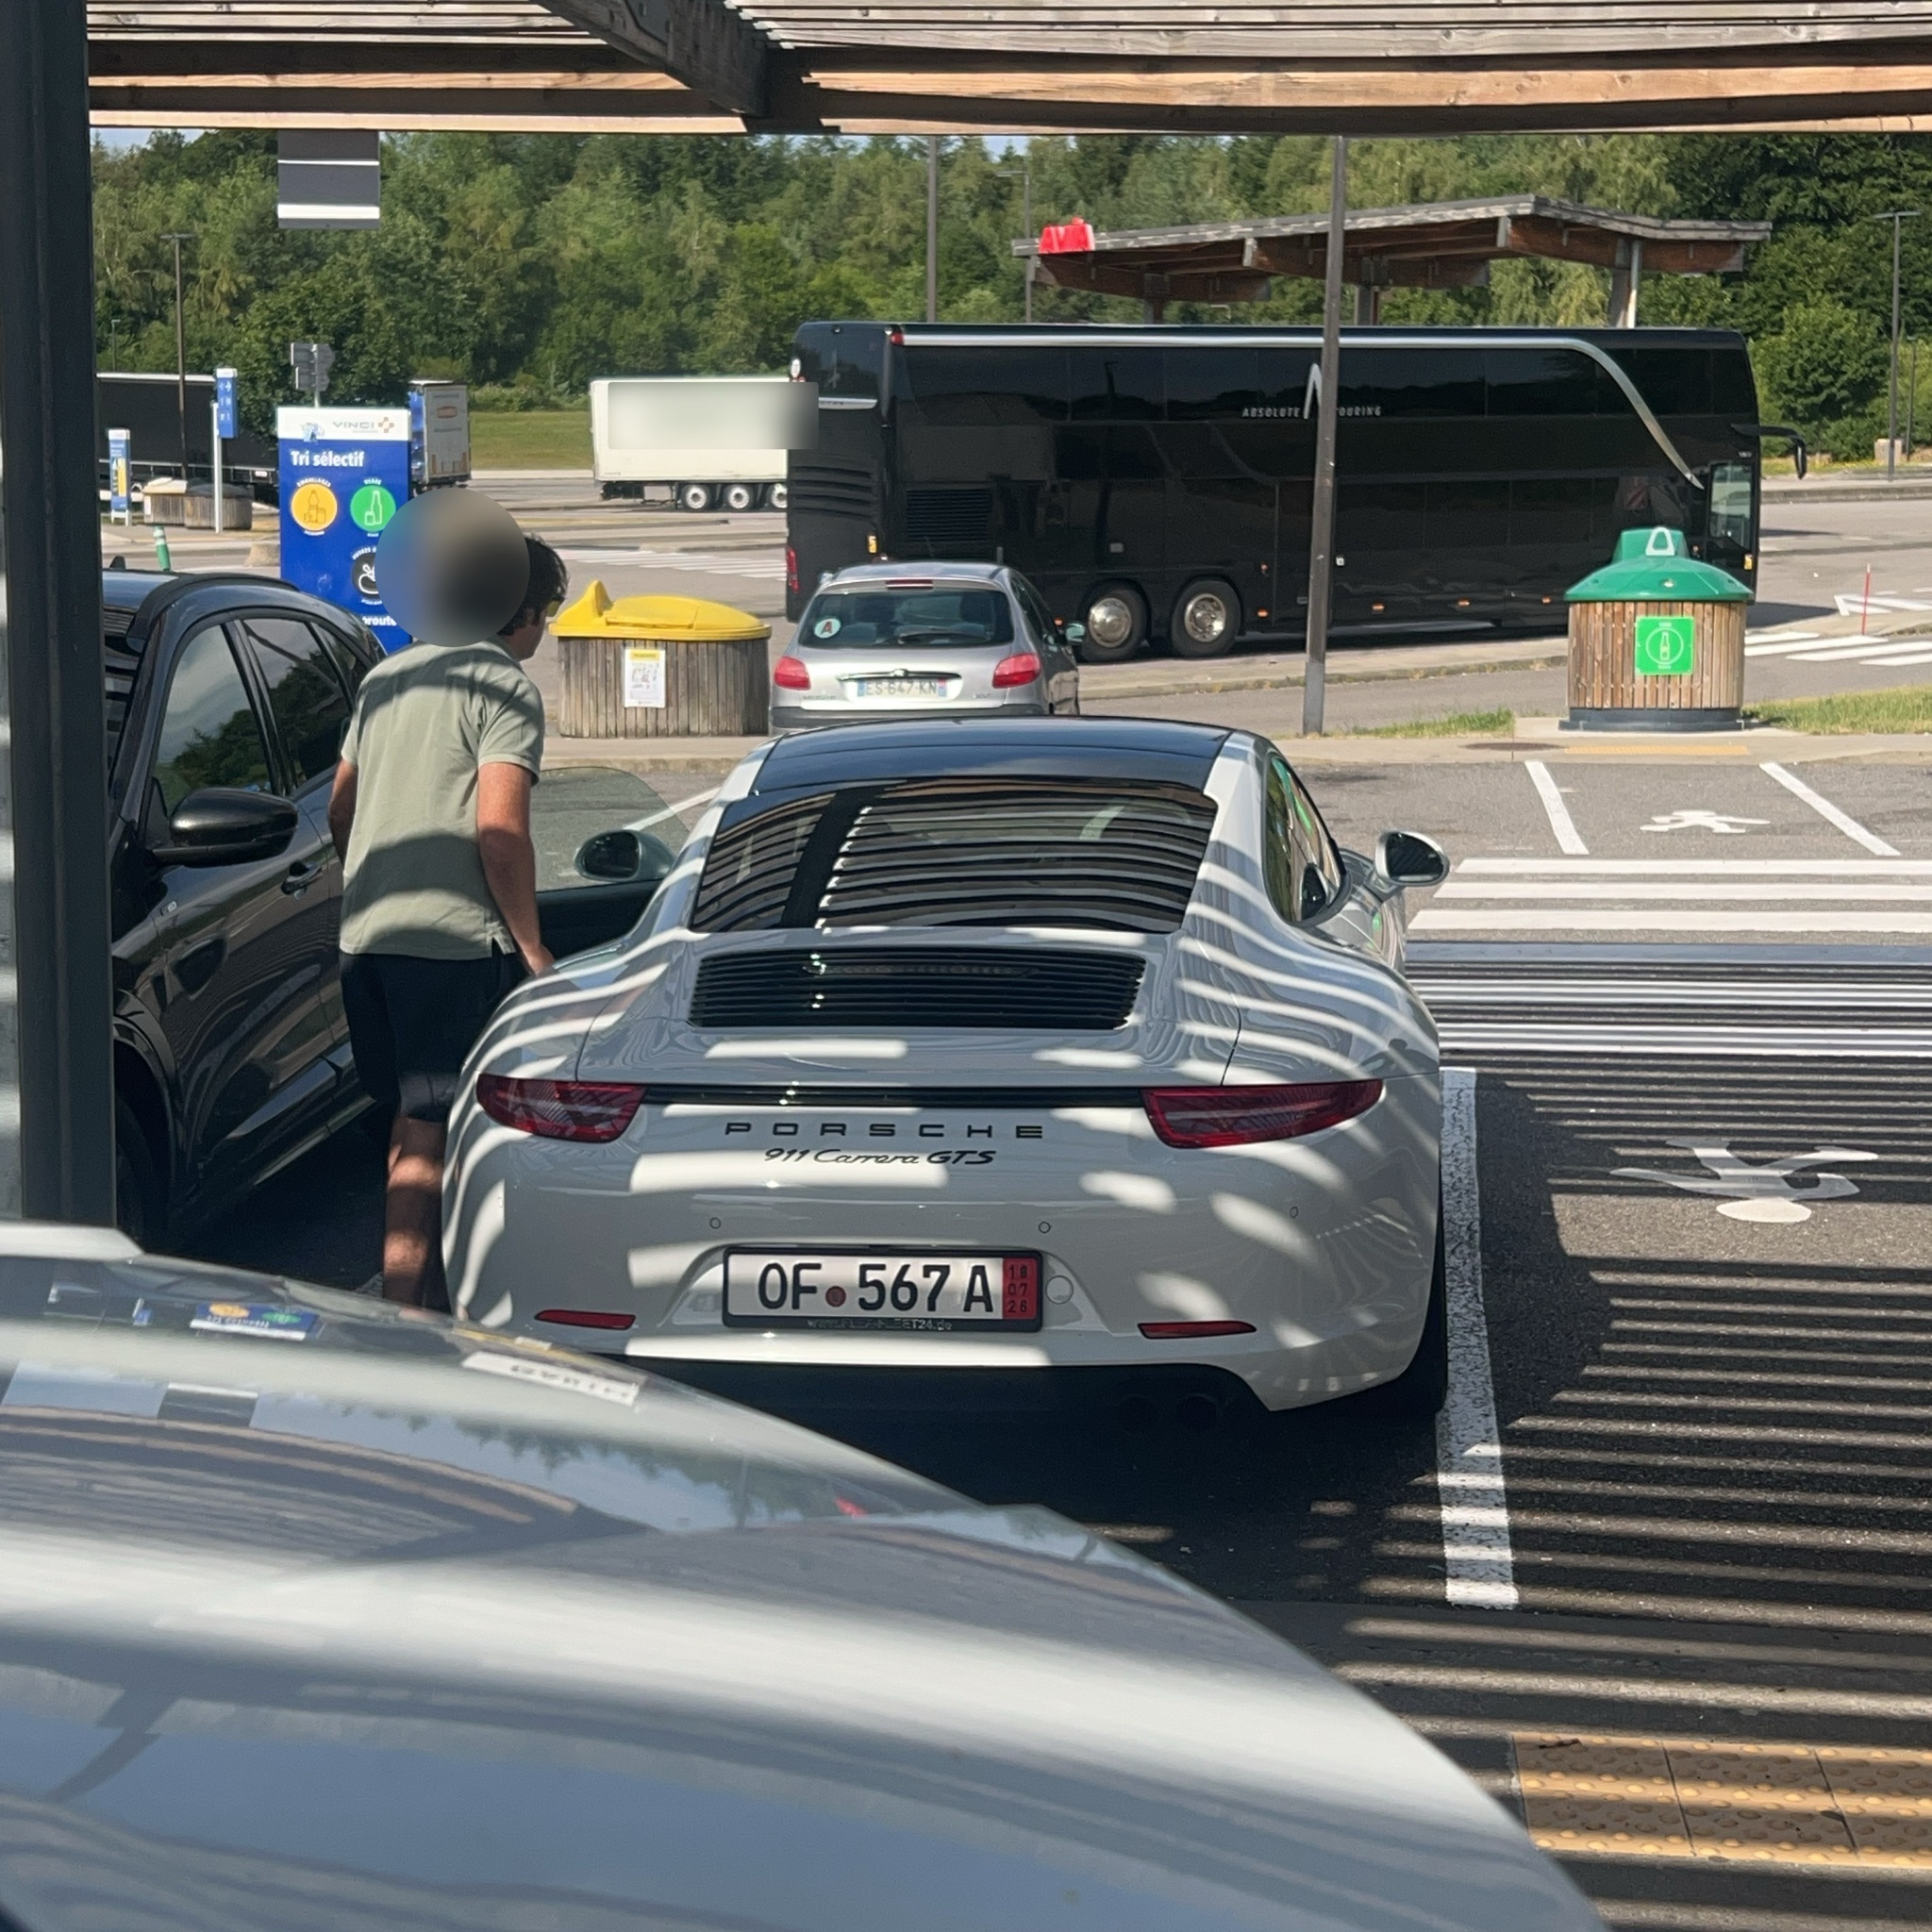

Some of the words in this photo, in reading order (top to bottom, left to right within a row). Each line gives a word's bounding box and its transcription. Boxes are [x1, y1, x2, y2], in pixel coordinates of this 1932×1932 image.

[1241, 407, 1301, 418] ABSOLUTE
[1336, 406, 1382, 417] OURING
[332, 421, 375, 429] VINCI
[291, 450, 310, 466] Tri
[312, 450, 365, 467] sélectif
[820, 621, 833, 635] A
[724, 1122, 1043, 1139] PORSCHE
[764, 1148, 810, 1162] 911
[813, 1149, 920, 1164] Carrera
[926, 1150, 996, 1165] GTS
[758, 1262, 822, 1310] OF
[858, 1263, 951, 1312] 567
[962, 1264, 993, 1313] A
